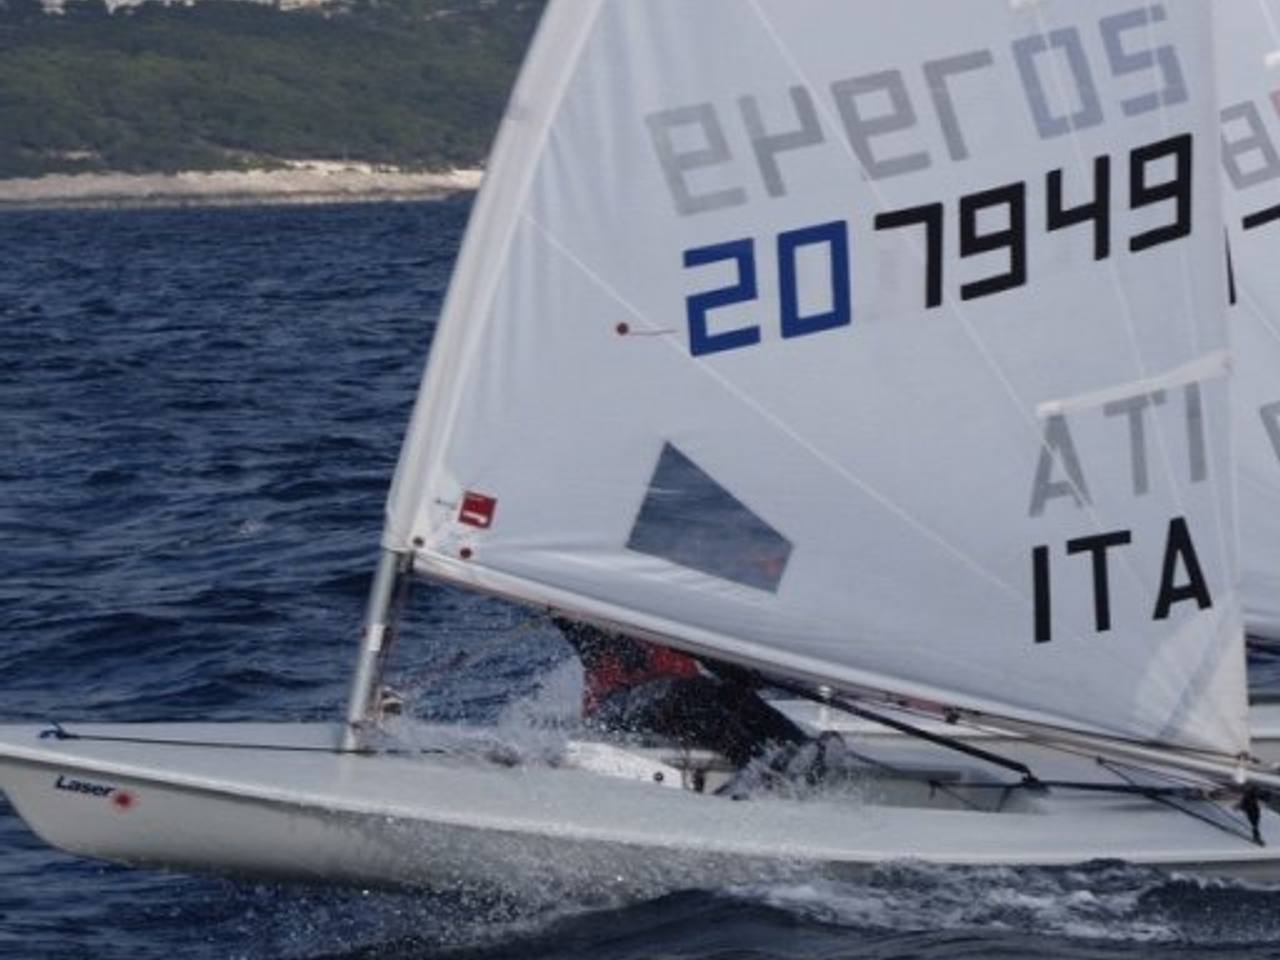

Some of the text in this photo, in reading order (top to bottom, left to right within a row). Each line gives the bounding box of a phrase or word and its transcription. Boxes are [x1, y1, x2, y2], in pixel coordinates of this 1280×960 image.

[683, 132, 1192, 357] 207949
[1032, 516, 1212, 643] ITA
[55, 775, 117, 797] Laser
